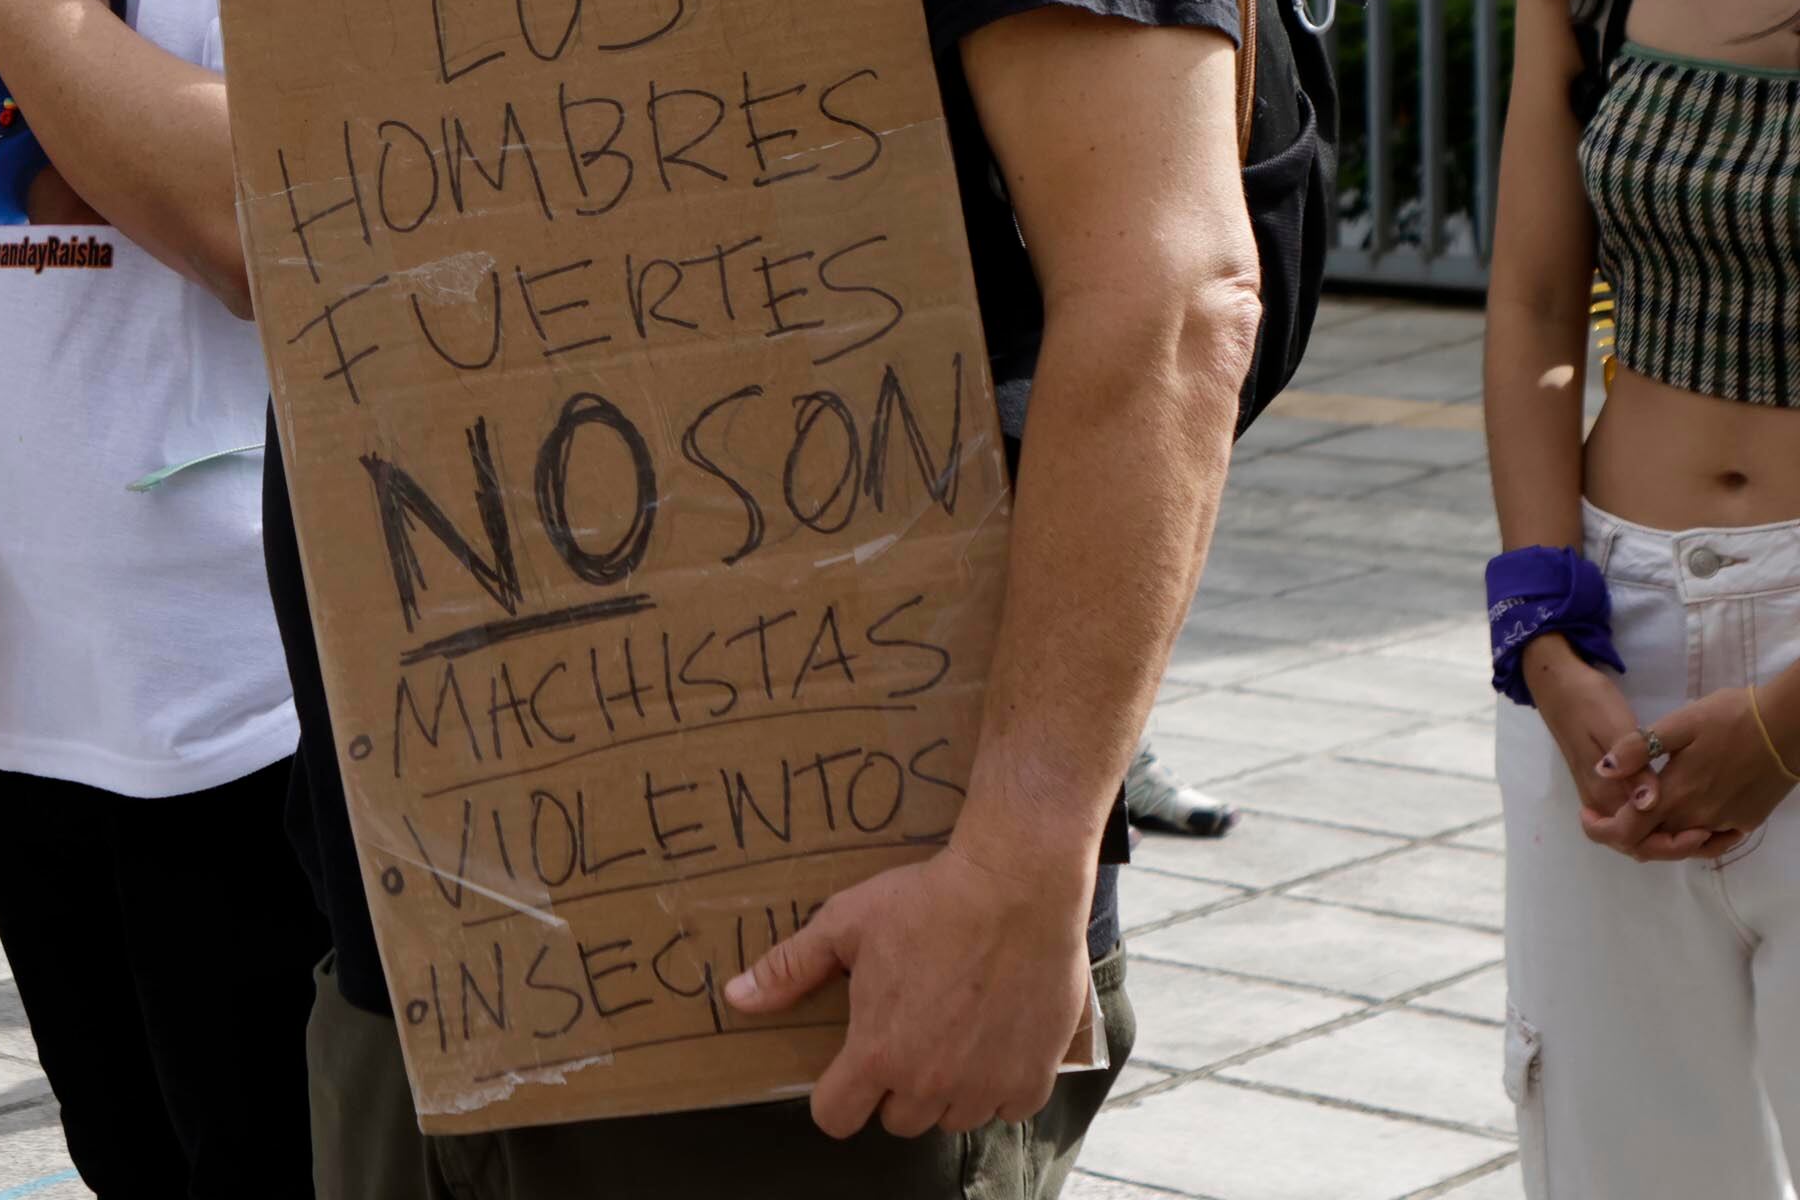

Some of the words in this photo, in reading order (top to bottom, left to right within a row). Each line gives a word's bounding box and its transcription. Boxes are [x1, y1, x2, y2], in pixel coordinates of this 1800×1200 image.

[277, 68, 884, 285] HOMBRES
[287, 235, 905, 406] FUERTES
[358, 390, 659, 633] NO
[679, 351, 965, 568] SON
[394, 596, 952, 779] MACHISTAS
[403, 738, 969, 910] VIOLENTOS
